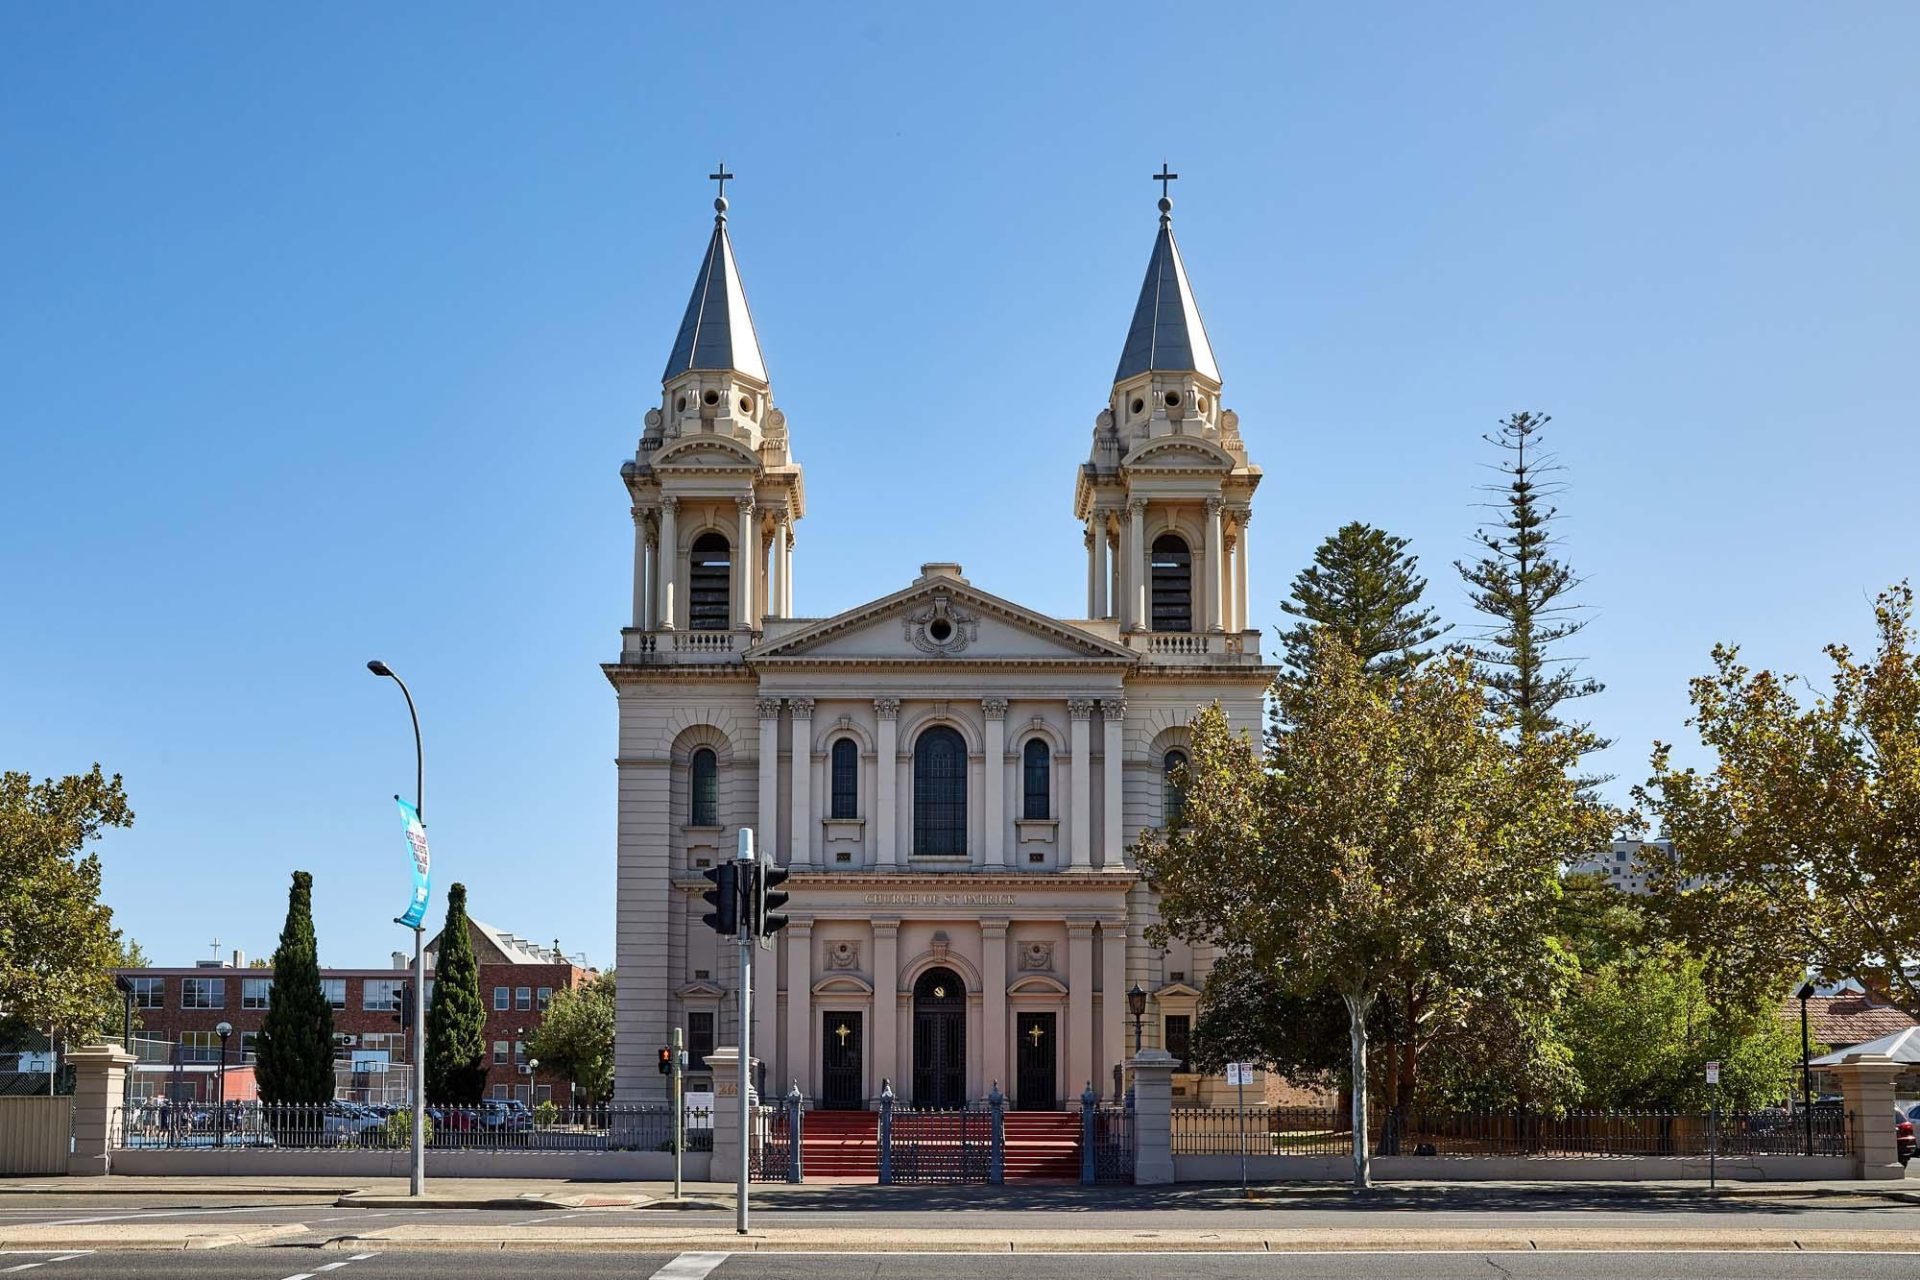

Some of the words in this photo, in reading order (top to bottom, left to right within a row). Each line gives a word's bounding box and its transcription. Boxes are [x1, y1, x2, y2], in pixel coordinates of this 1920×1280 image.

[865, 894, 918, 905] CHURCH
[923, 894, 938, 905] OF
[963, 894, 1016, 905] PATRICK
